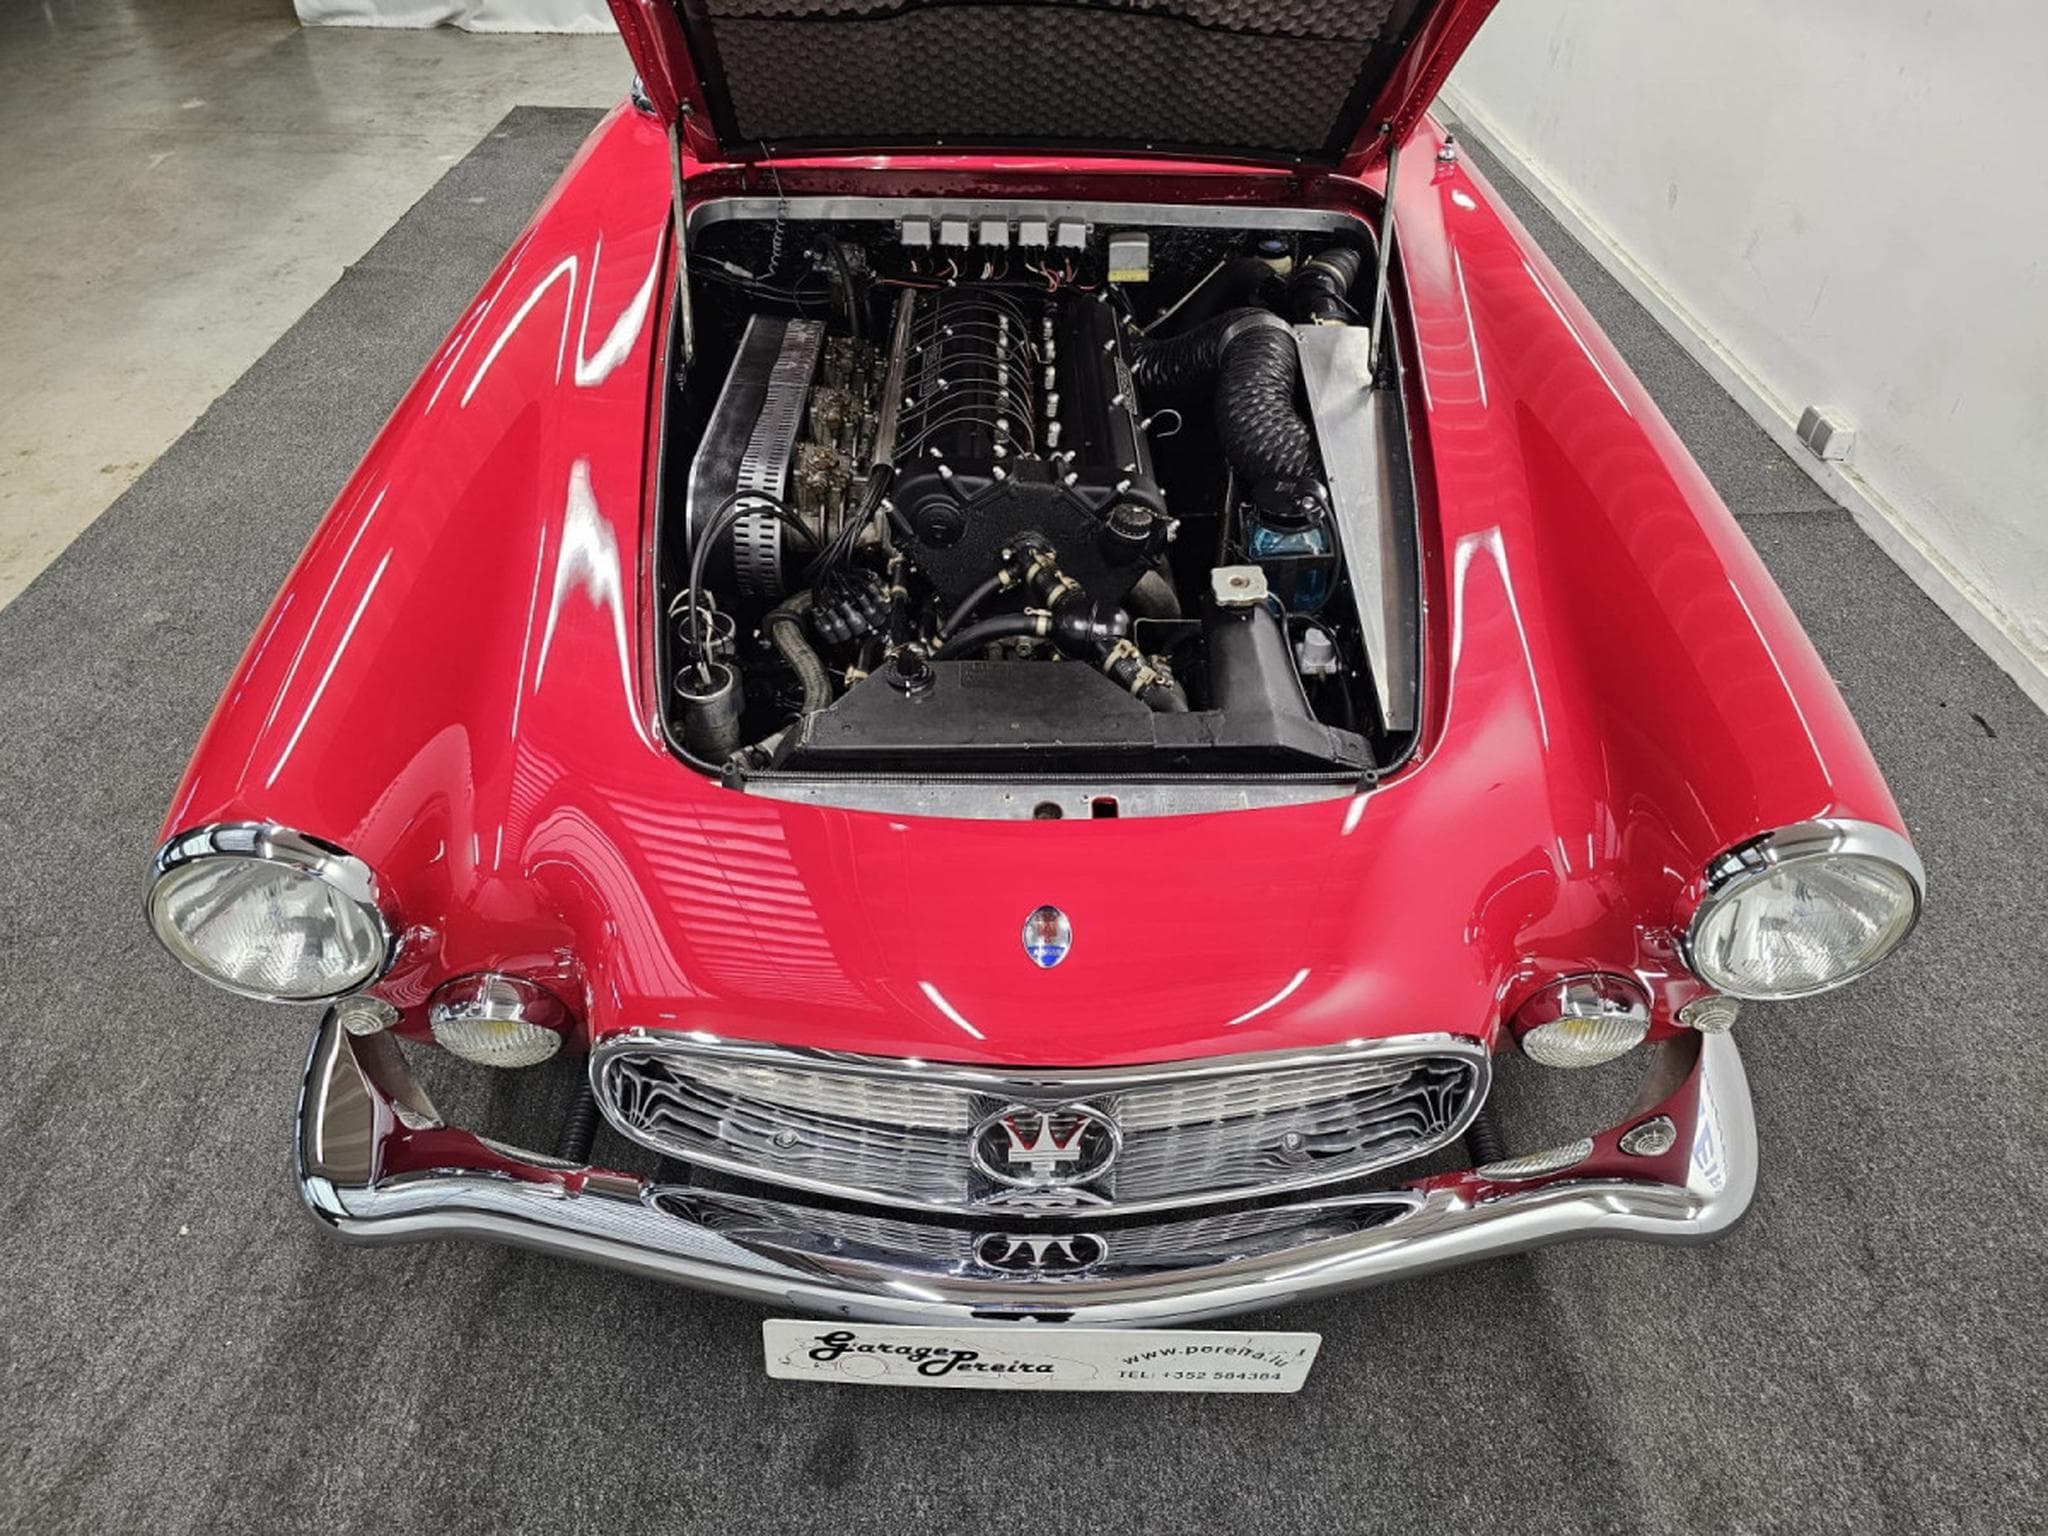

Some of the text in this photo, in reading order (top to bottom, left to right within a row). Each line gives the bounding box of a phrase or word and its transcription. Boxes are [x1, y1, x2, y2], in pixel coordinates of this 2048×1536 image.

[808, 1330, 1054, 1377] Garage Pereira
[1161, 1371, 1207, 1380] +352
